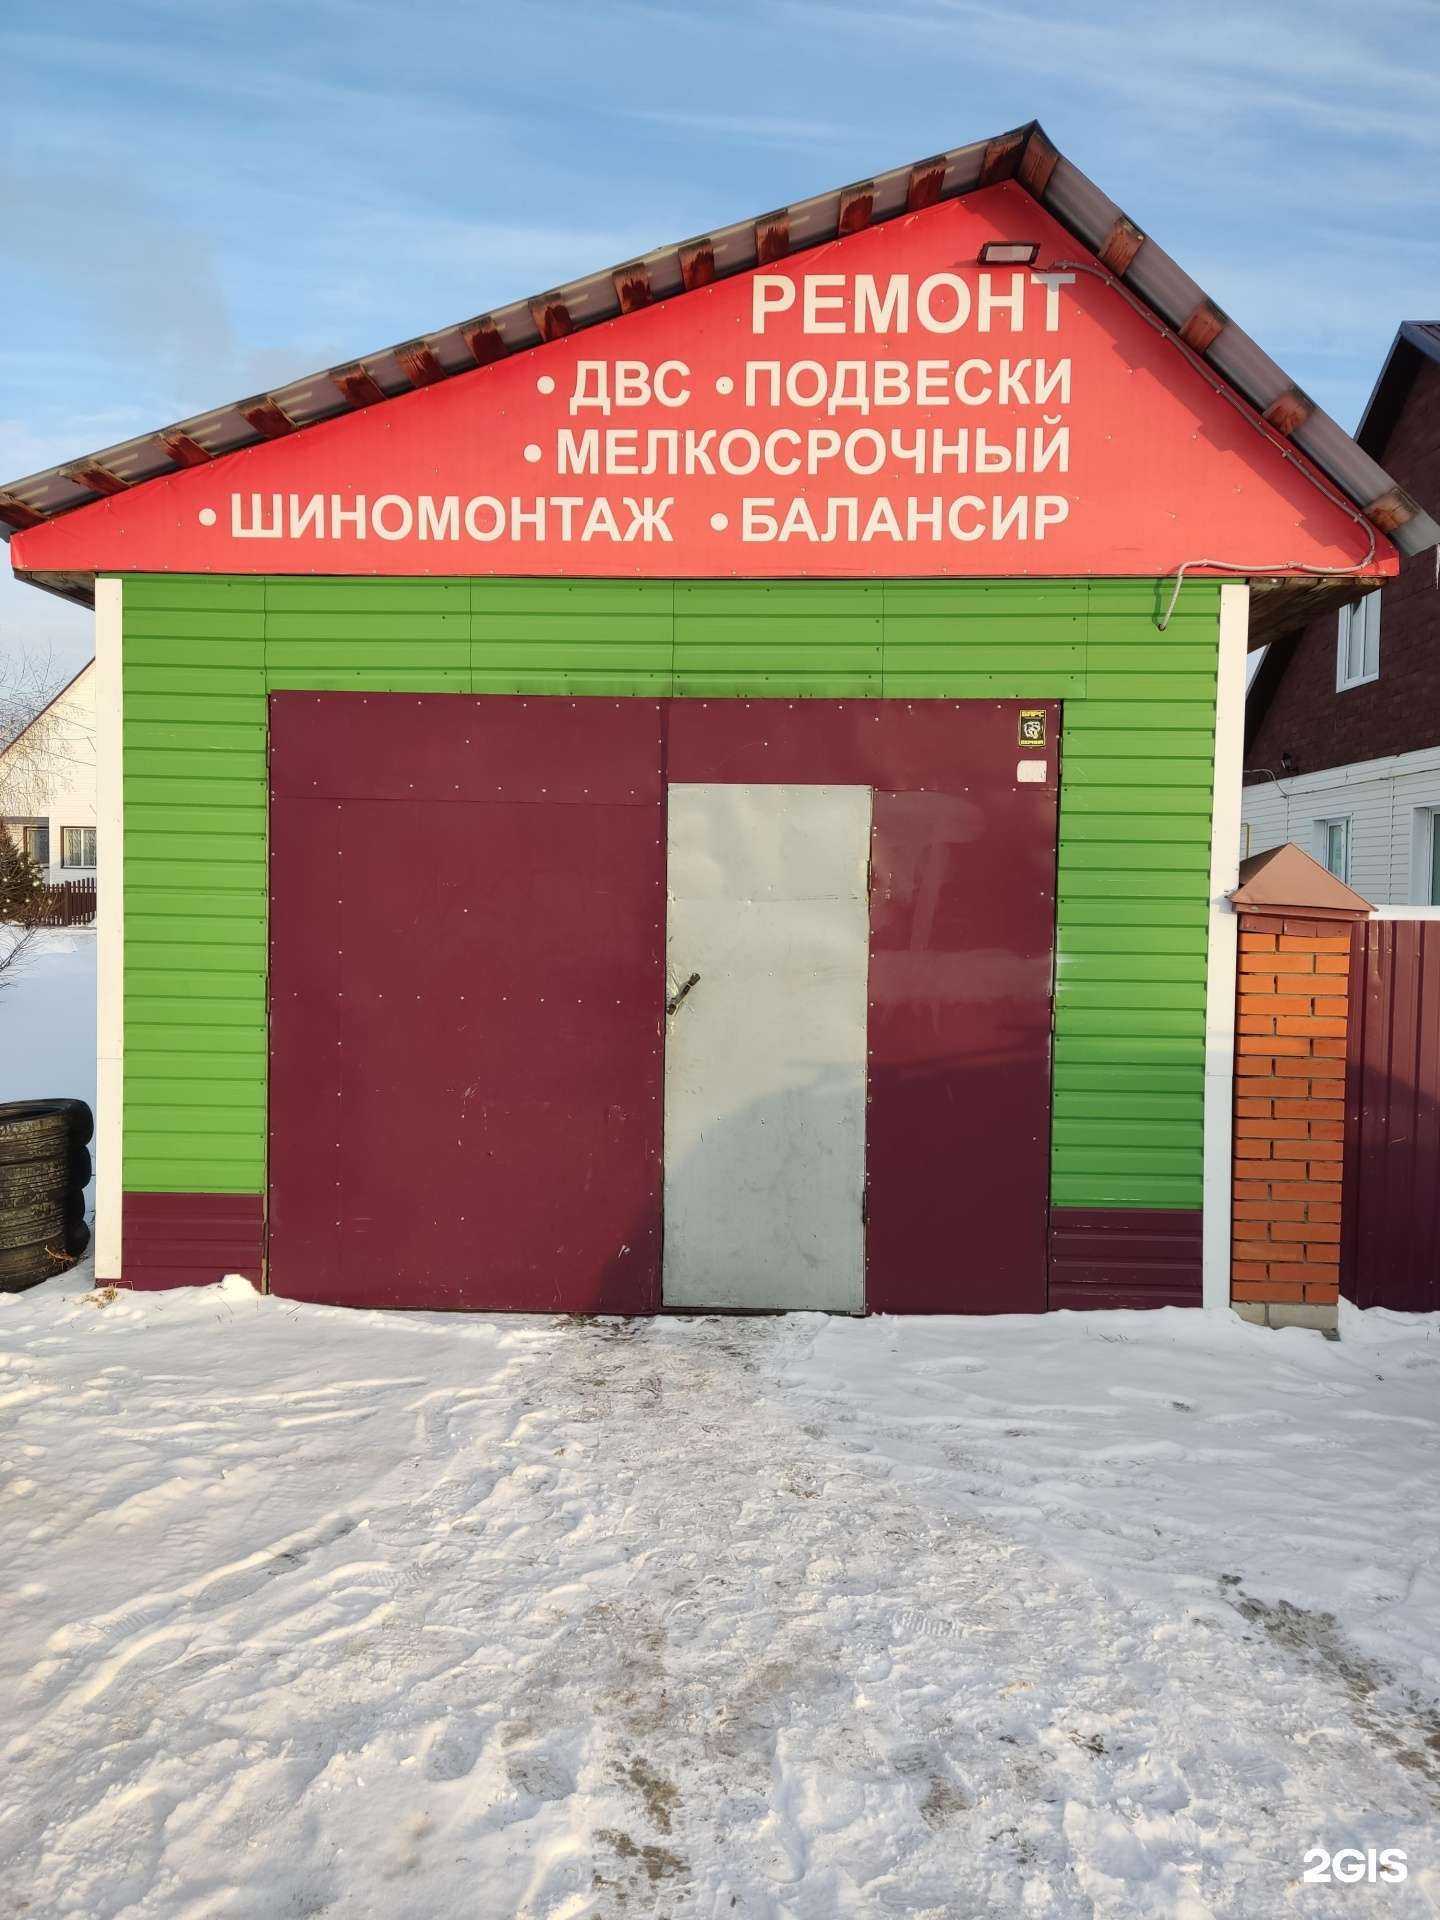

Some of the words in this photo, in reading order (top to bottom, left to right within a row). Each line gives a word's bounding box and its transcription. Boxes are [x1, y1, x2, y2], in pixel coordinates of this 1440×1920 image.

[752, 272, 1076, 334] РЕМОНТ
[569, 360, 690, 416] ДВС
[745, 358, 1071, 416] ПОДВЕСКИ
[557, 414, 1071, 476] МЕЛКОСРОЧНЫЙ
[231, 493, 674, 542] ШИНОМОНТАЖ
[742, 495, 1070, 542] БАЛАНСИР
